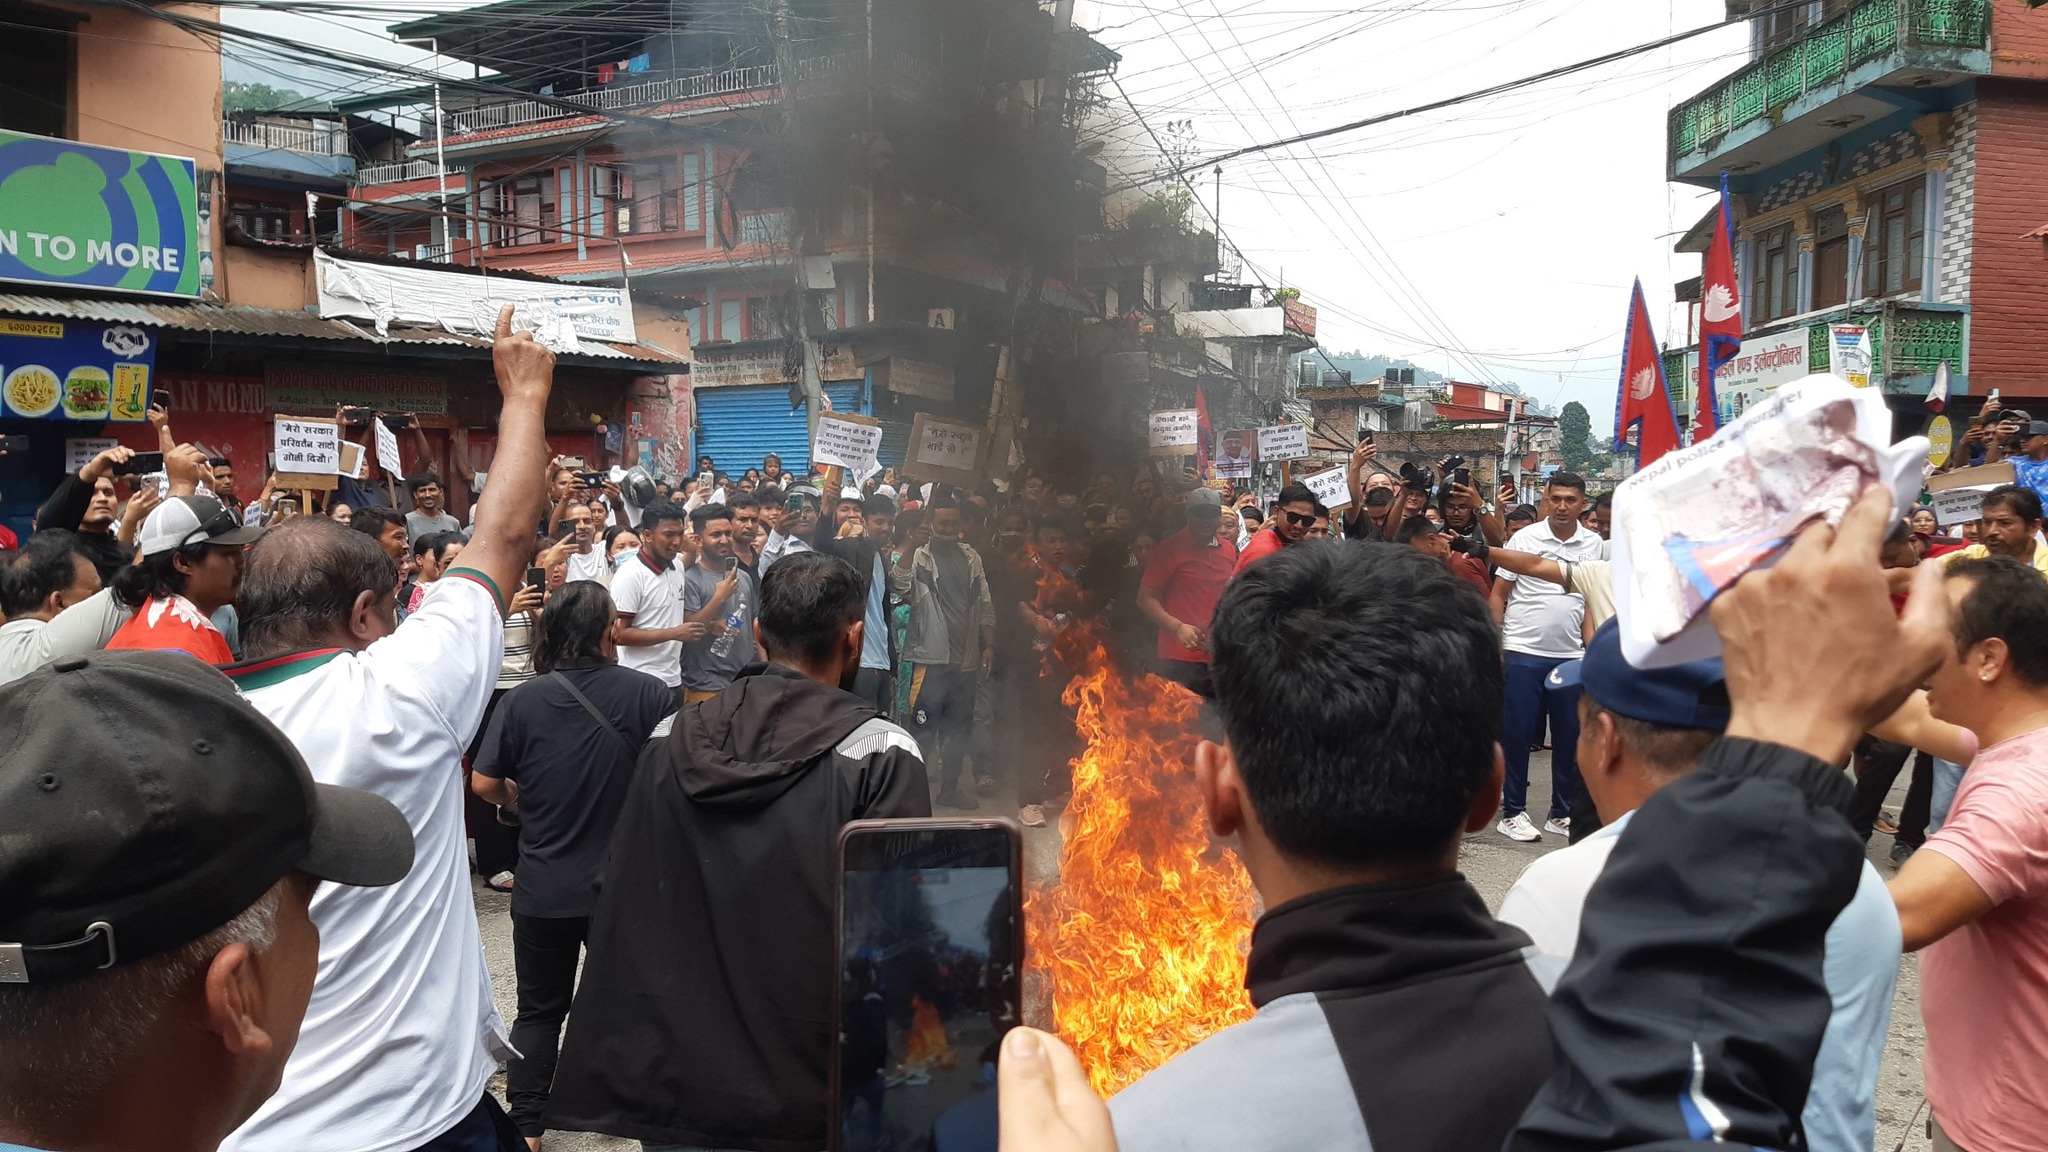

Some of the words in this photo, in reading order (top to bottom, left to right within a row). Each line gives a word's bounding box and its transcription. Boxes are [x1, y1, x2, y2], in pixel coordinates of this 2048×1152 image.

[26, 231, 76, 261] TO
[86, 238, 180, 273] MORE
[934, 312, 945, 327] A
[205, 382, 264, 413] MOMO
[303, 426, 334, 436] सरकार
[280, 437, 313, 449] परिवर्तन
[283, 452, 303, 462] गोली
[1629, 460, 1672, 490] Nepal
[1676, 439, 1726, 468] police
